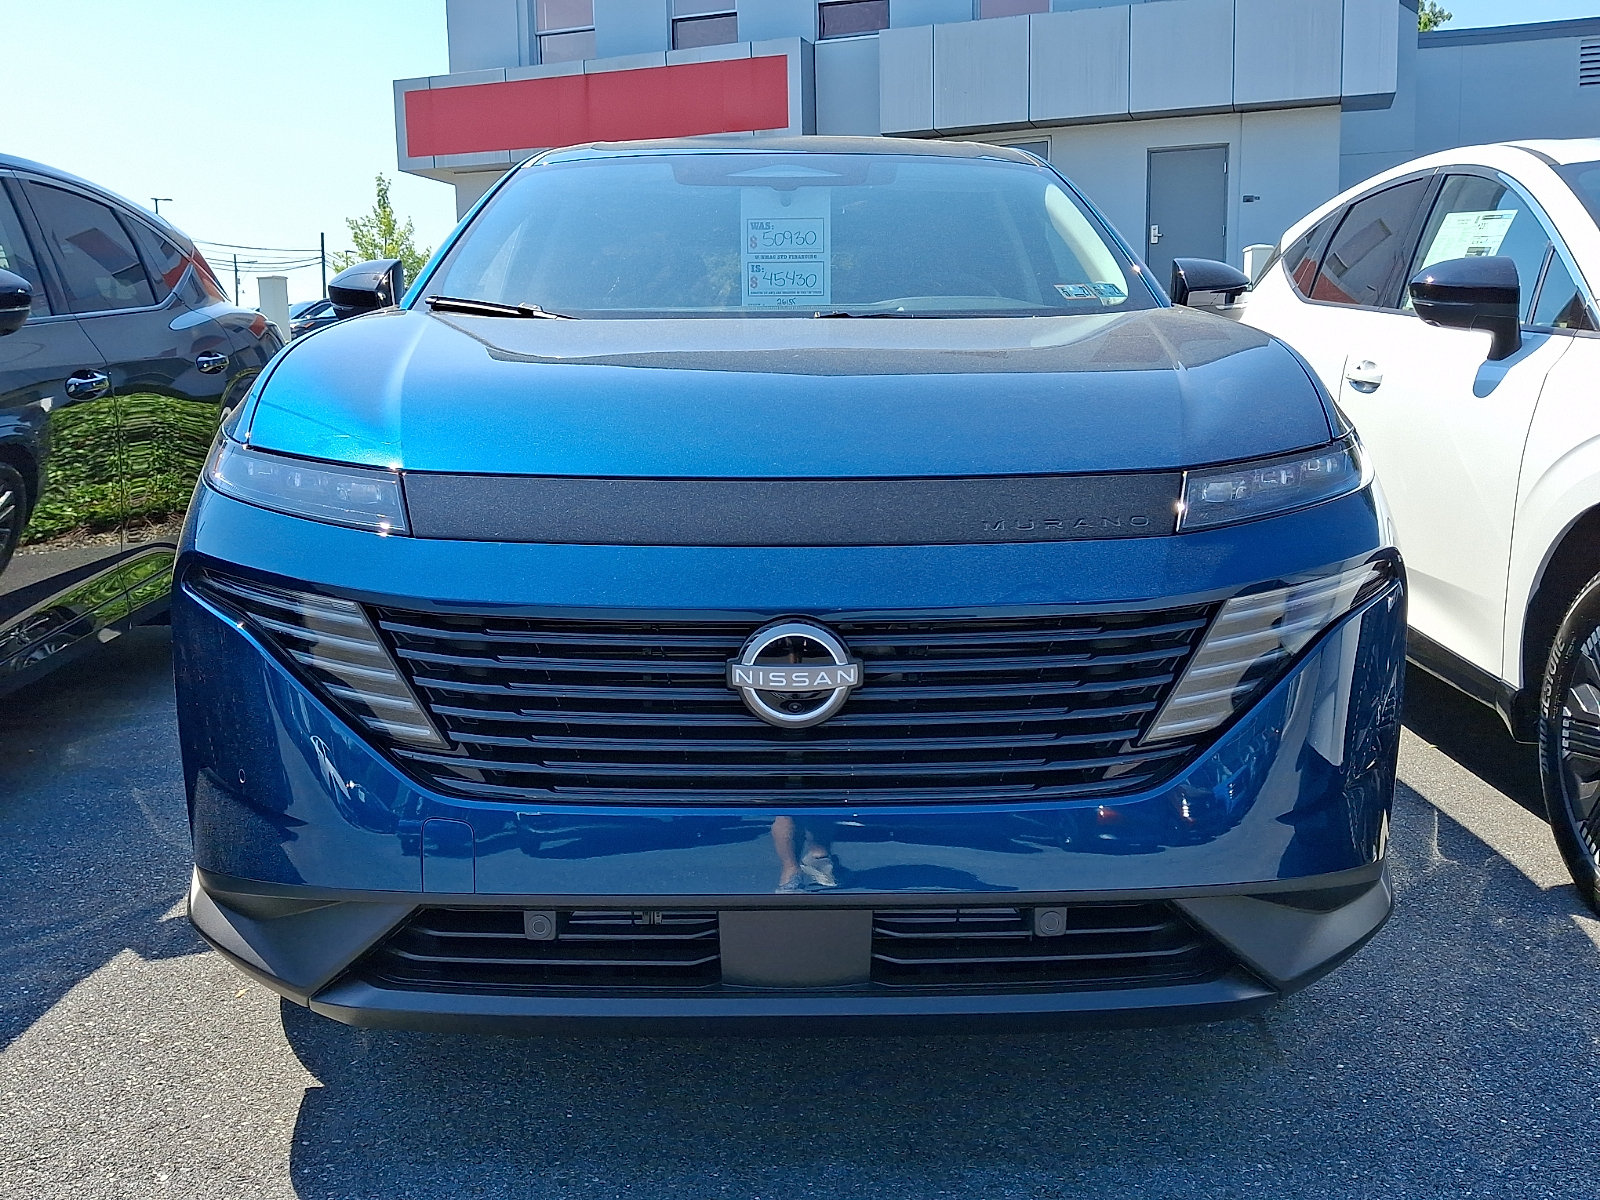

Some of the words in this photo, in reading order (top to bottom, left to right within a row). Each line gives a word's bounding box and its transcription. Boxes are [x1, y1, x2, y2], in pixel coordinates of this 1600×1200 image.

[750, 222, 774, 230] WAS:
[763, 230, 817, 247] 50930
[750, 264, 765, 272] IS:
[762, 270, 817, 288] 45430
[982, 515, 1150, 532] MURANO
[735, 668, 854, 687] NISSAN
